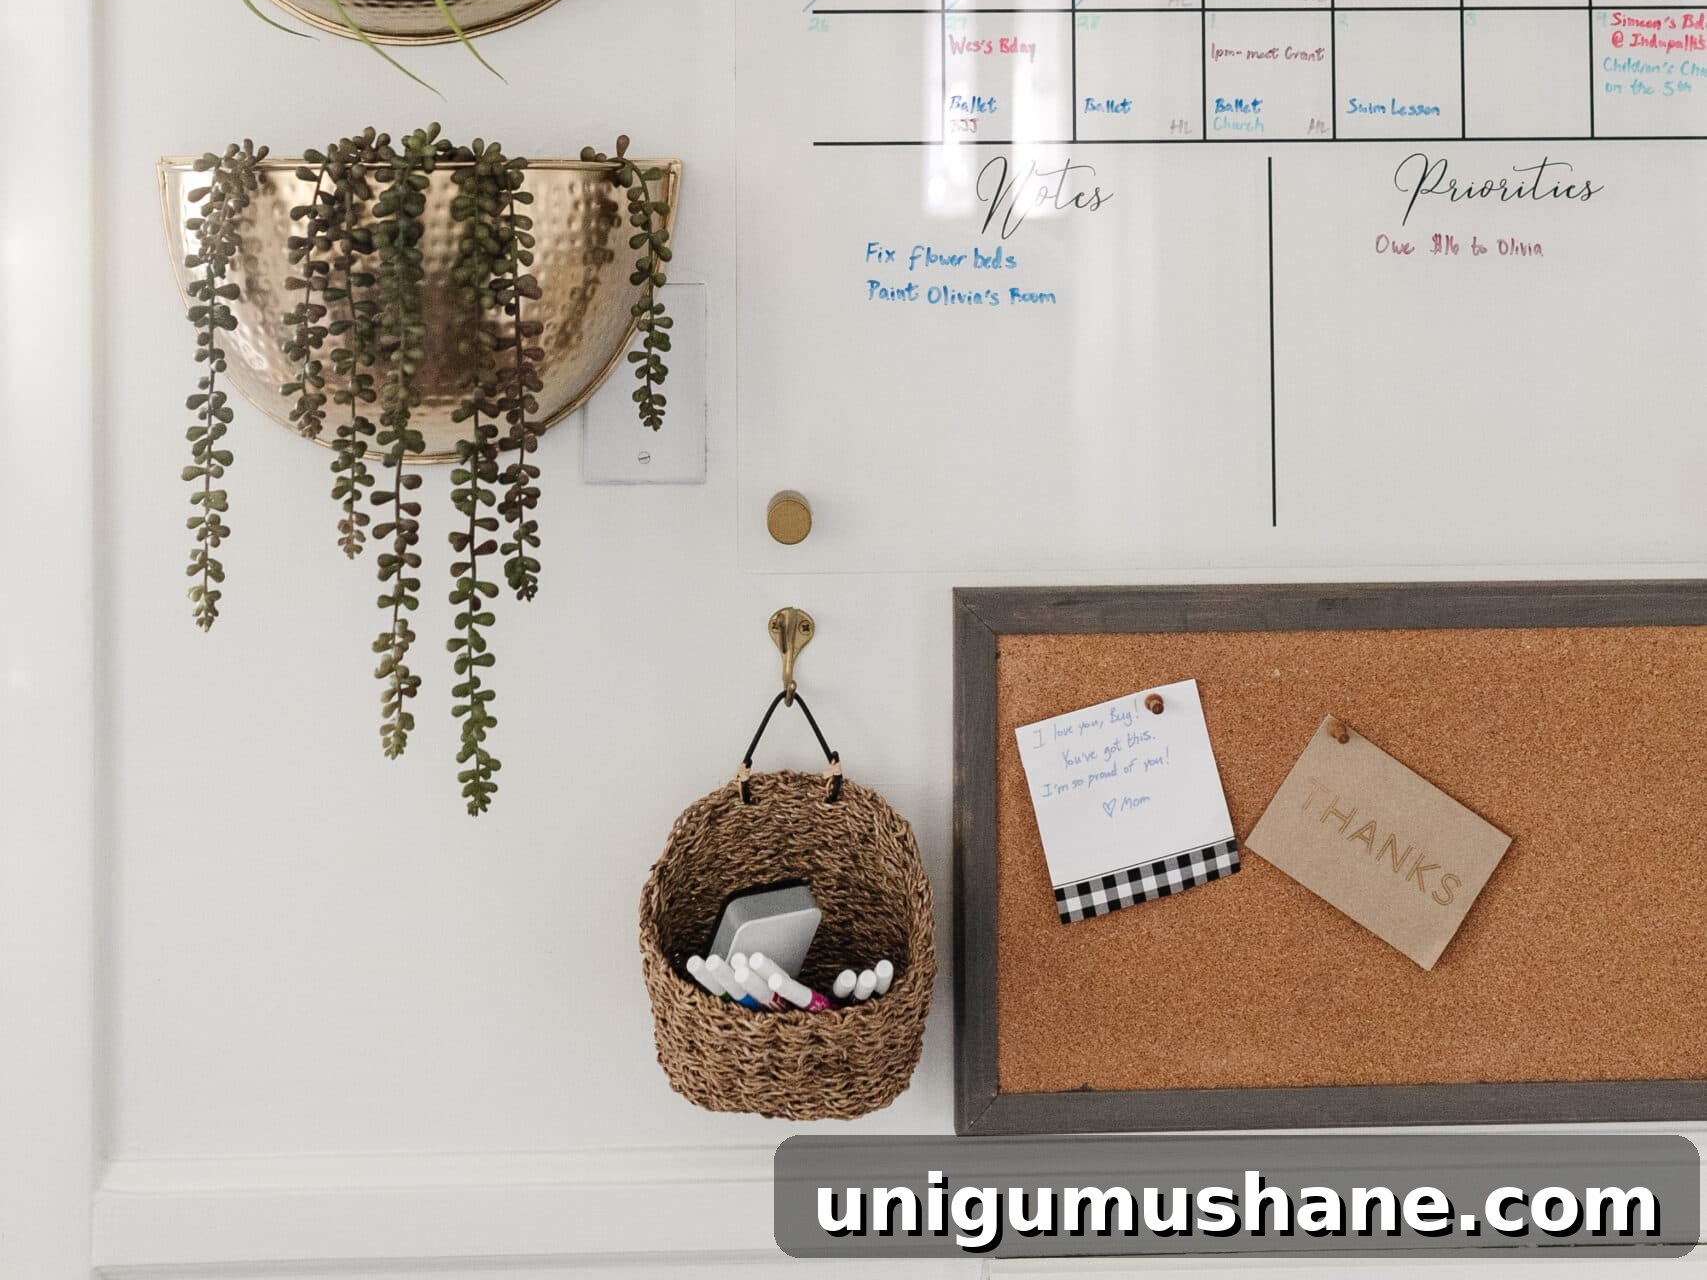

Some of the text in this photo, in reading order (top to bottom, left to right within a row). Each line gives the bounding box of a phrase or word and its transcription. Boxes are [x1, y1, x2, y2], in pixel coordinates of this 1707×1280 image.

[1682, 12, 1707, 31] Bd
[949, 34, 1036, 63] Wes's Bday
[1611, 30, 1624, 48] @
[1284, 45, 1326, 62] Grant
[1604, 81, 1622, 94] on
[1630, 79, 1656, 96] the
[950, 95, 998, 114] Ballet
[1084, 96, 1133, 114] Ballet
[1214, 97, 1263, 114] Ballet
[1346, 97, 1440, 116] Swim Lesson
[1212, 116, 1264, 133] Church
[976, 156, 1114, 240] Notes
[1394, 153, 1604, 226] Priorities
[1375, 233, 1415, 255] Owe
[1470, 236, 1489, 257] to
[1497, 236, 1544, 257] Olivia
[865, 241, 1018, 271] Fix flower beds
[866, 279, 1057, 306] Paint Olivia's Room
[1053, 723, 1074, 741] love
[1103, 737, 1122, 761] got
[1087, 760, 1118, 789] proud
[1120, 795, 1152, 812] Mom
[1302, 778, 1463, 906] THANKS
